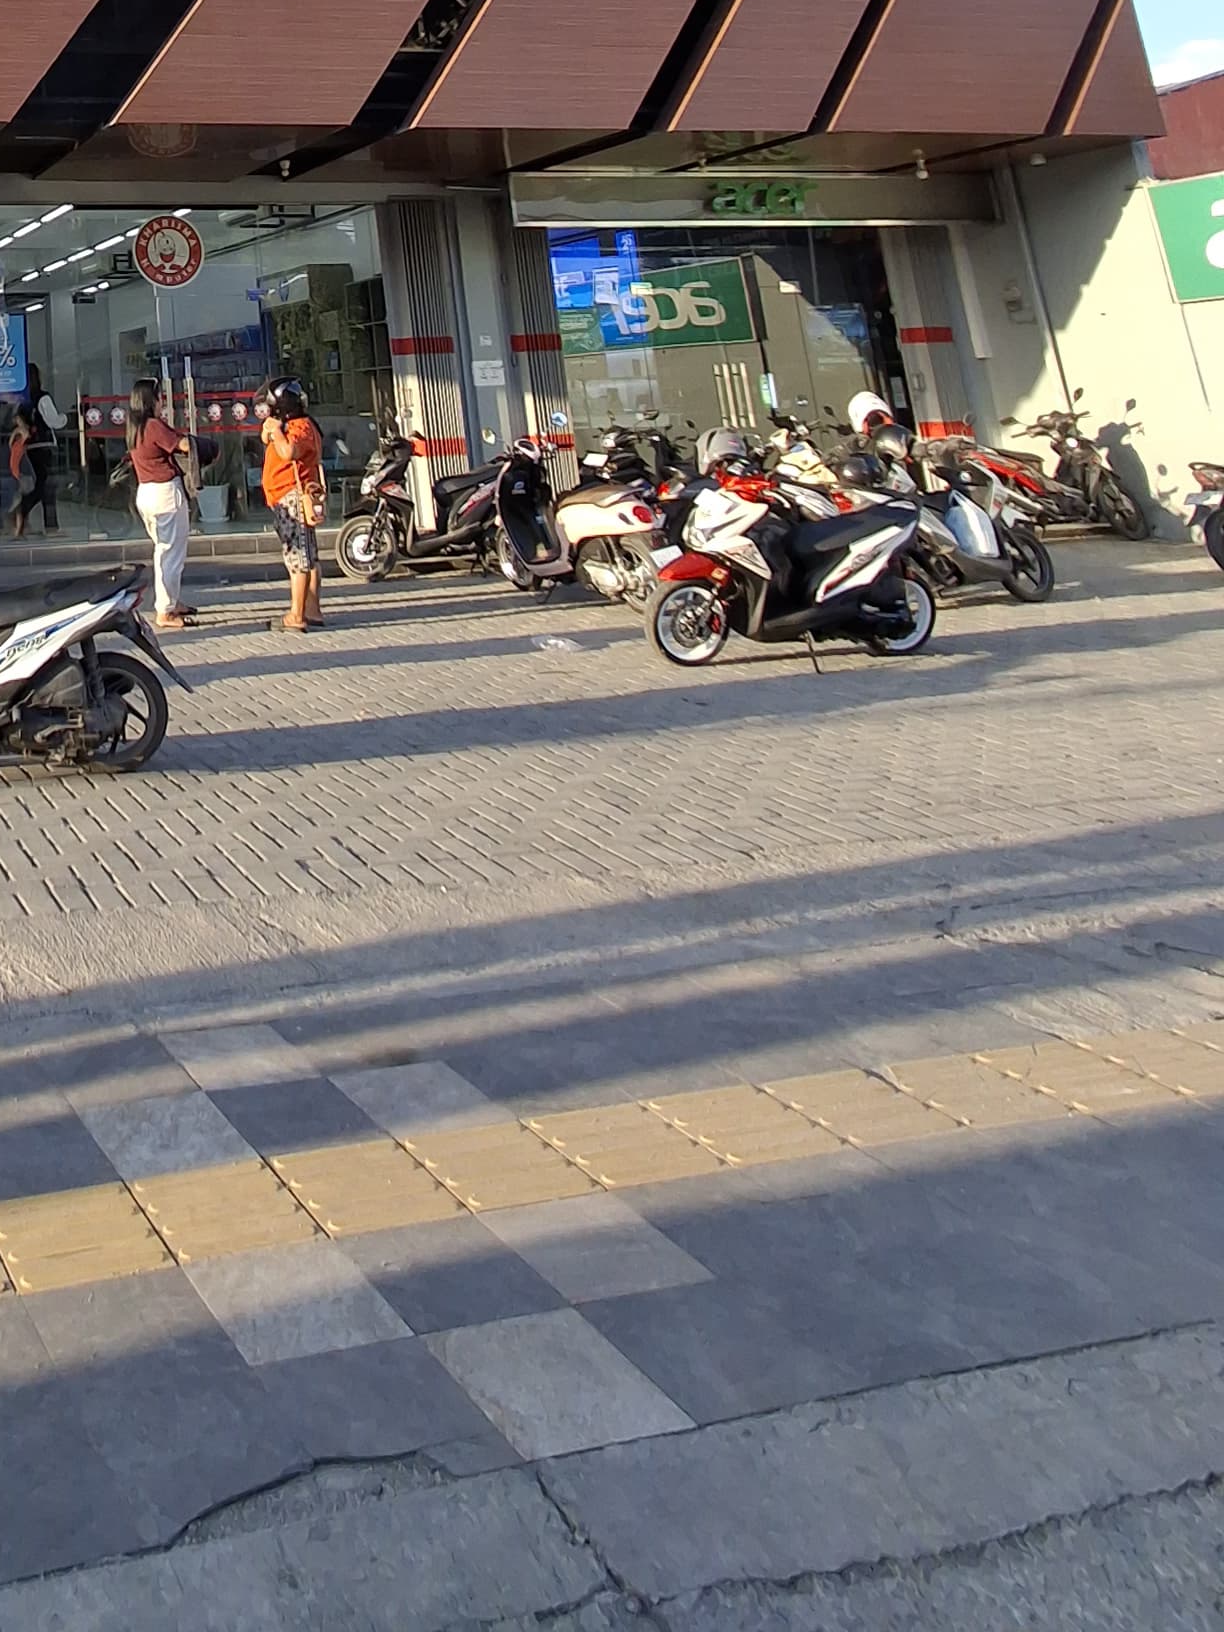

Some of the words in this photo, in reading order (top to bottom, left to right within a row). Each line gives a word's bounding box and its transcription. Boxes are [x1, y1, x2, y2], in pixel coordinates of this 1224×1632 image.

[711, 180, 819, 215] acer
[138, 218, 198, 246] KHARISMA
[139, 258, 198, 284] Kmputer
